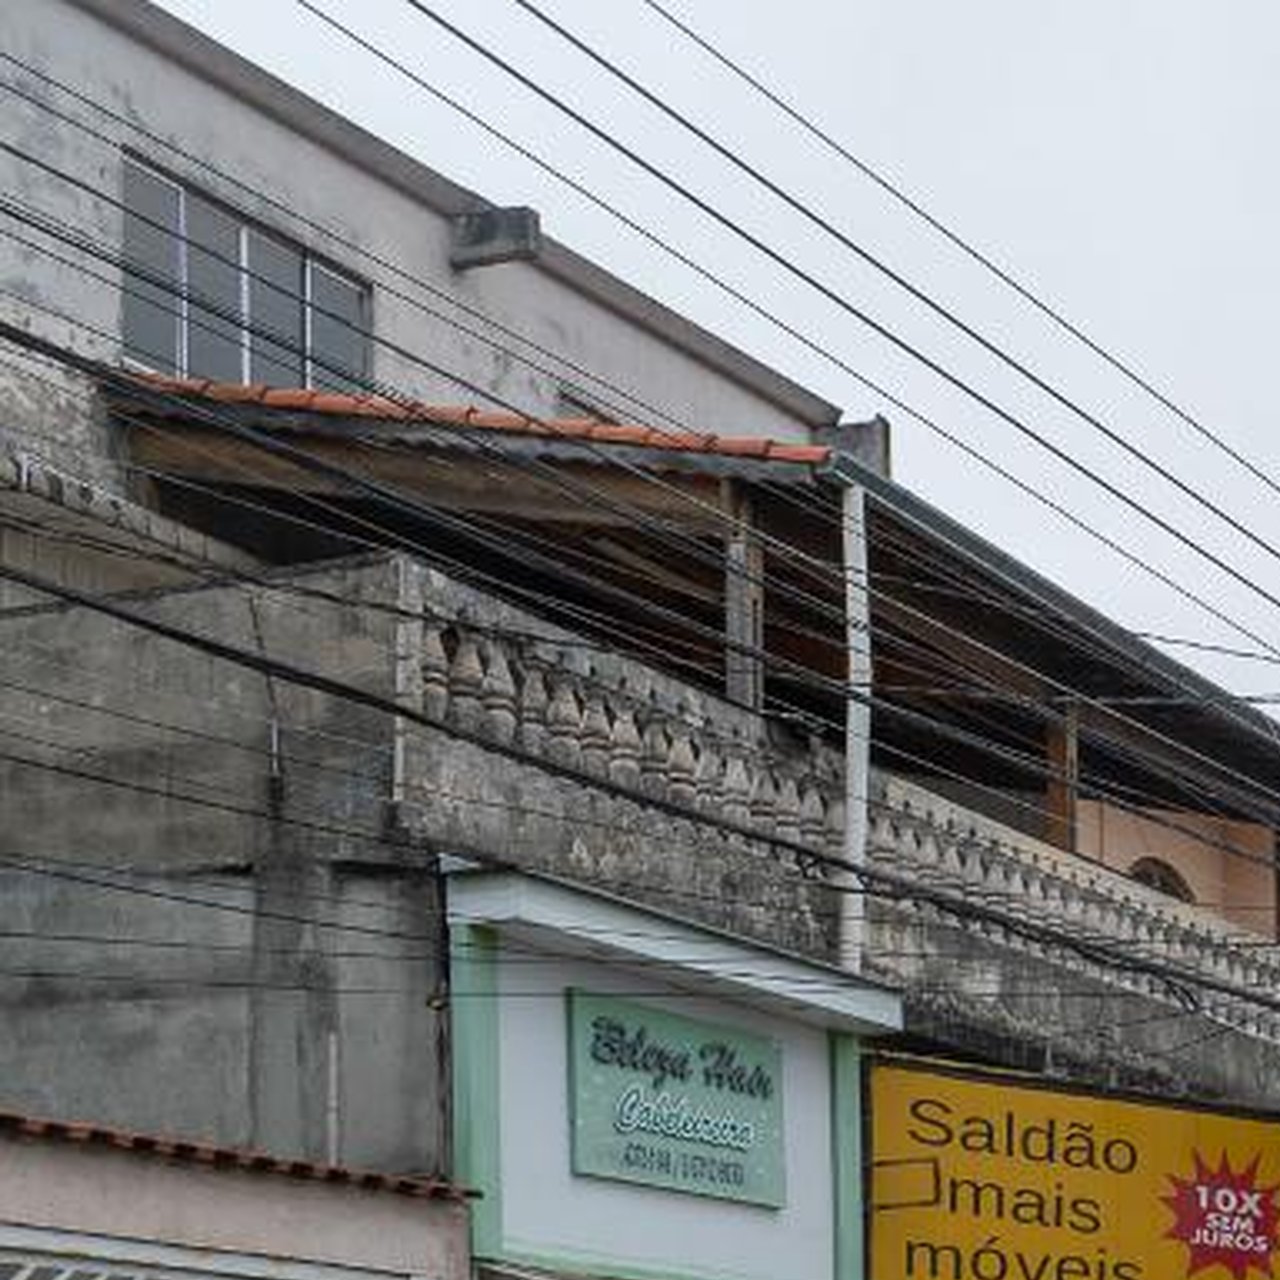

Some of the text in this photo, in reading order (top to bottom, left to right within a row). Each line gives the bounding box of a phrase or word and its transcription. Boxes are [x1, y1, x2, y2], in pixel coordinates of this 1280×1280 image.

[906, 1099, 1138, 1174] Saldão
[949, 1176, 1102, 1234] mais
[1195, 1185, 1264, 1219] 10X
[1189, 1227, 1269, 1252] JUROS
[1205, 1212, 1255, 1235] SEM
